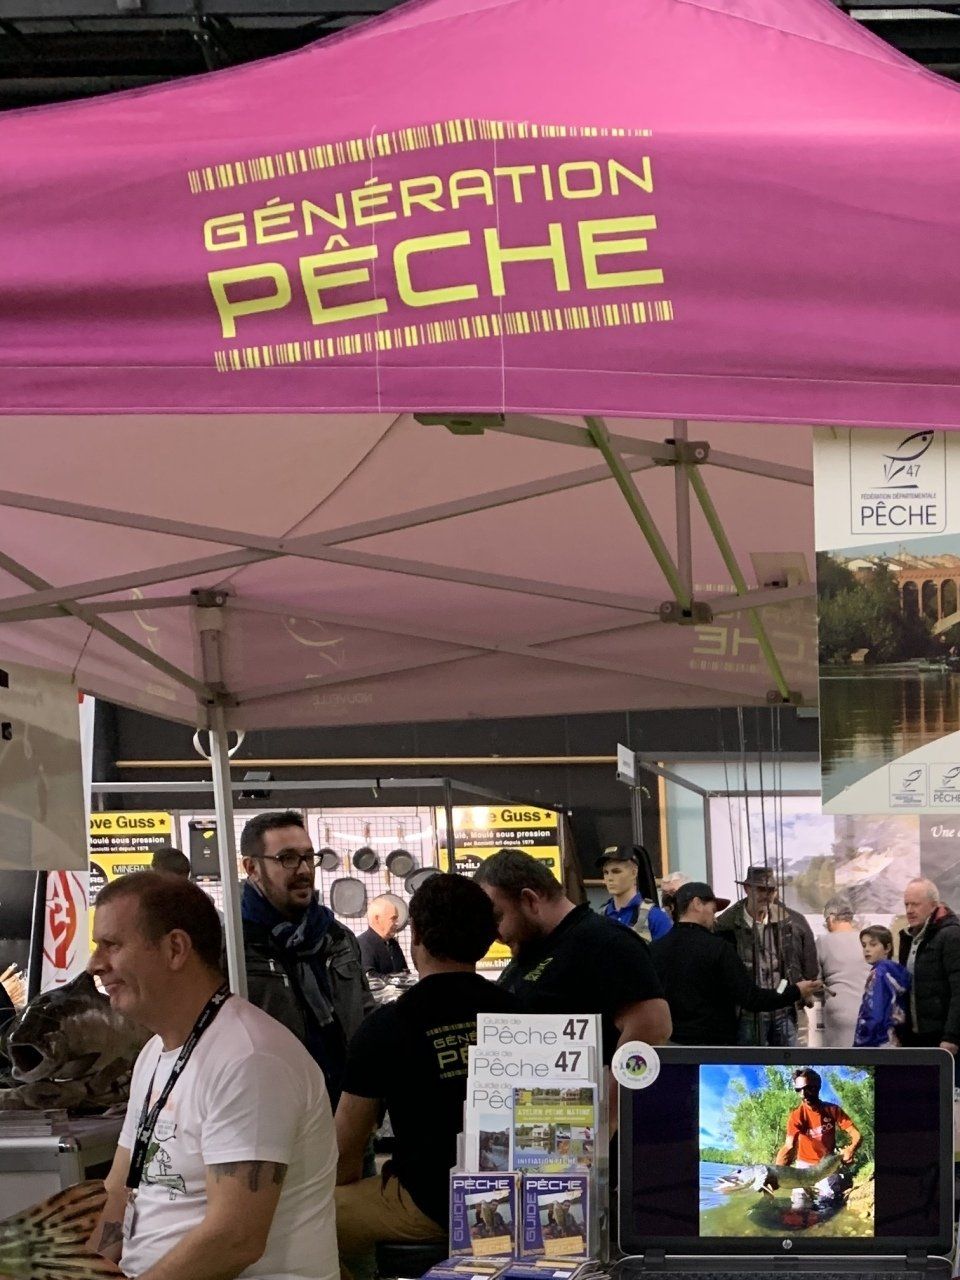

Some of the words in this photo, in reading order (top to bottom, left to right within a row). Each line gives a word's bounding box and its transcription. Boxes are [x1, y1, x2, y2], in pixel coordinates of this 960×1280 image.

[203, 156, 654, 252] GÉNÉRATION
[207, 215, 664, 339] PÊCHE
[906, 465, 921, 477] 47
[861, 501, 936, 526] PÊCHE
[116, 816, 155, 828] Guss
[501, 809, 540, 822] Guss
[517, 830, 550, 839] pression
[931, 825, 955, 838] Une
[483, 1026, 557, 1045] Pêche
[562, 1019, 589, 1040] 47
[474, 1058, 549, 1077] Pêche
[555, 1051, 582, 1072] 47
[453, 1178, 510, 1190] PÊCHE
[526, 1179, 582, 1190] PÊCHE
[454, 1191, 464, 1242] GUIDE
[526, 1192, 536, 1242] GUIDE
